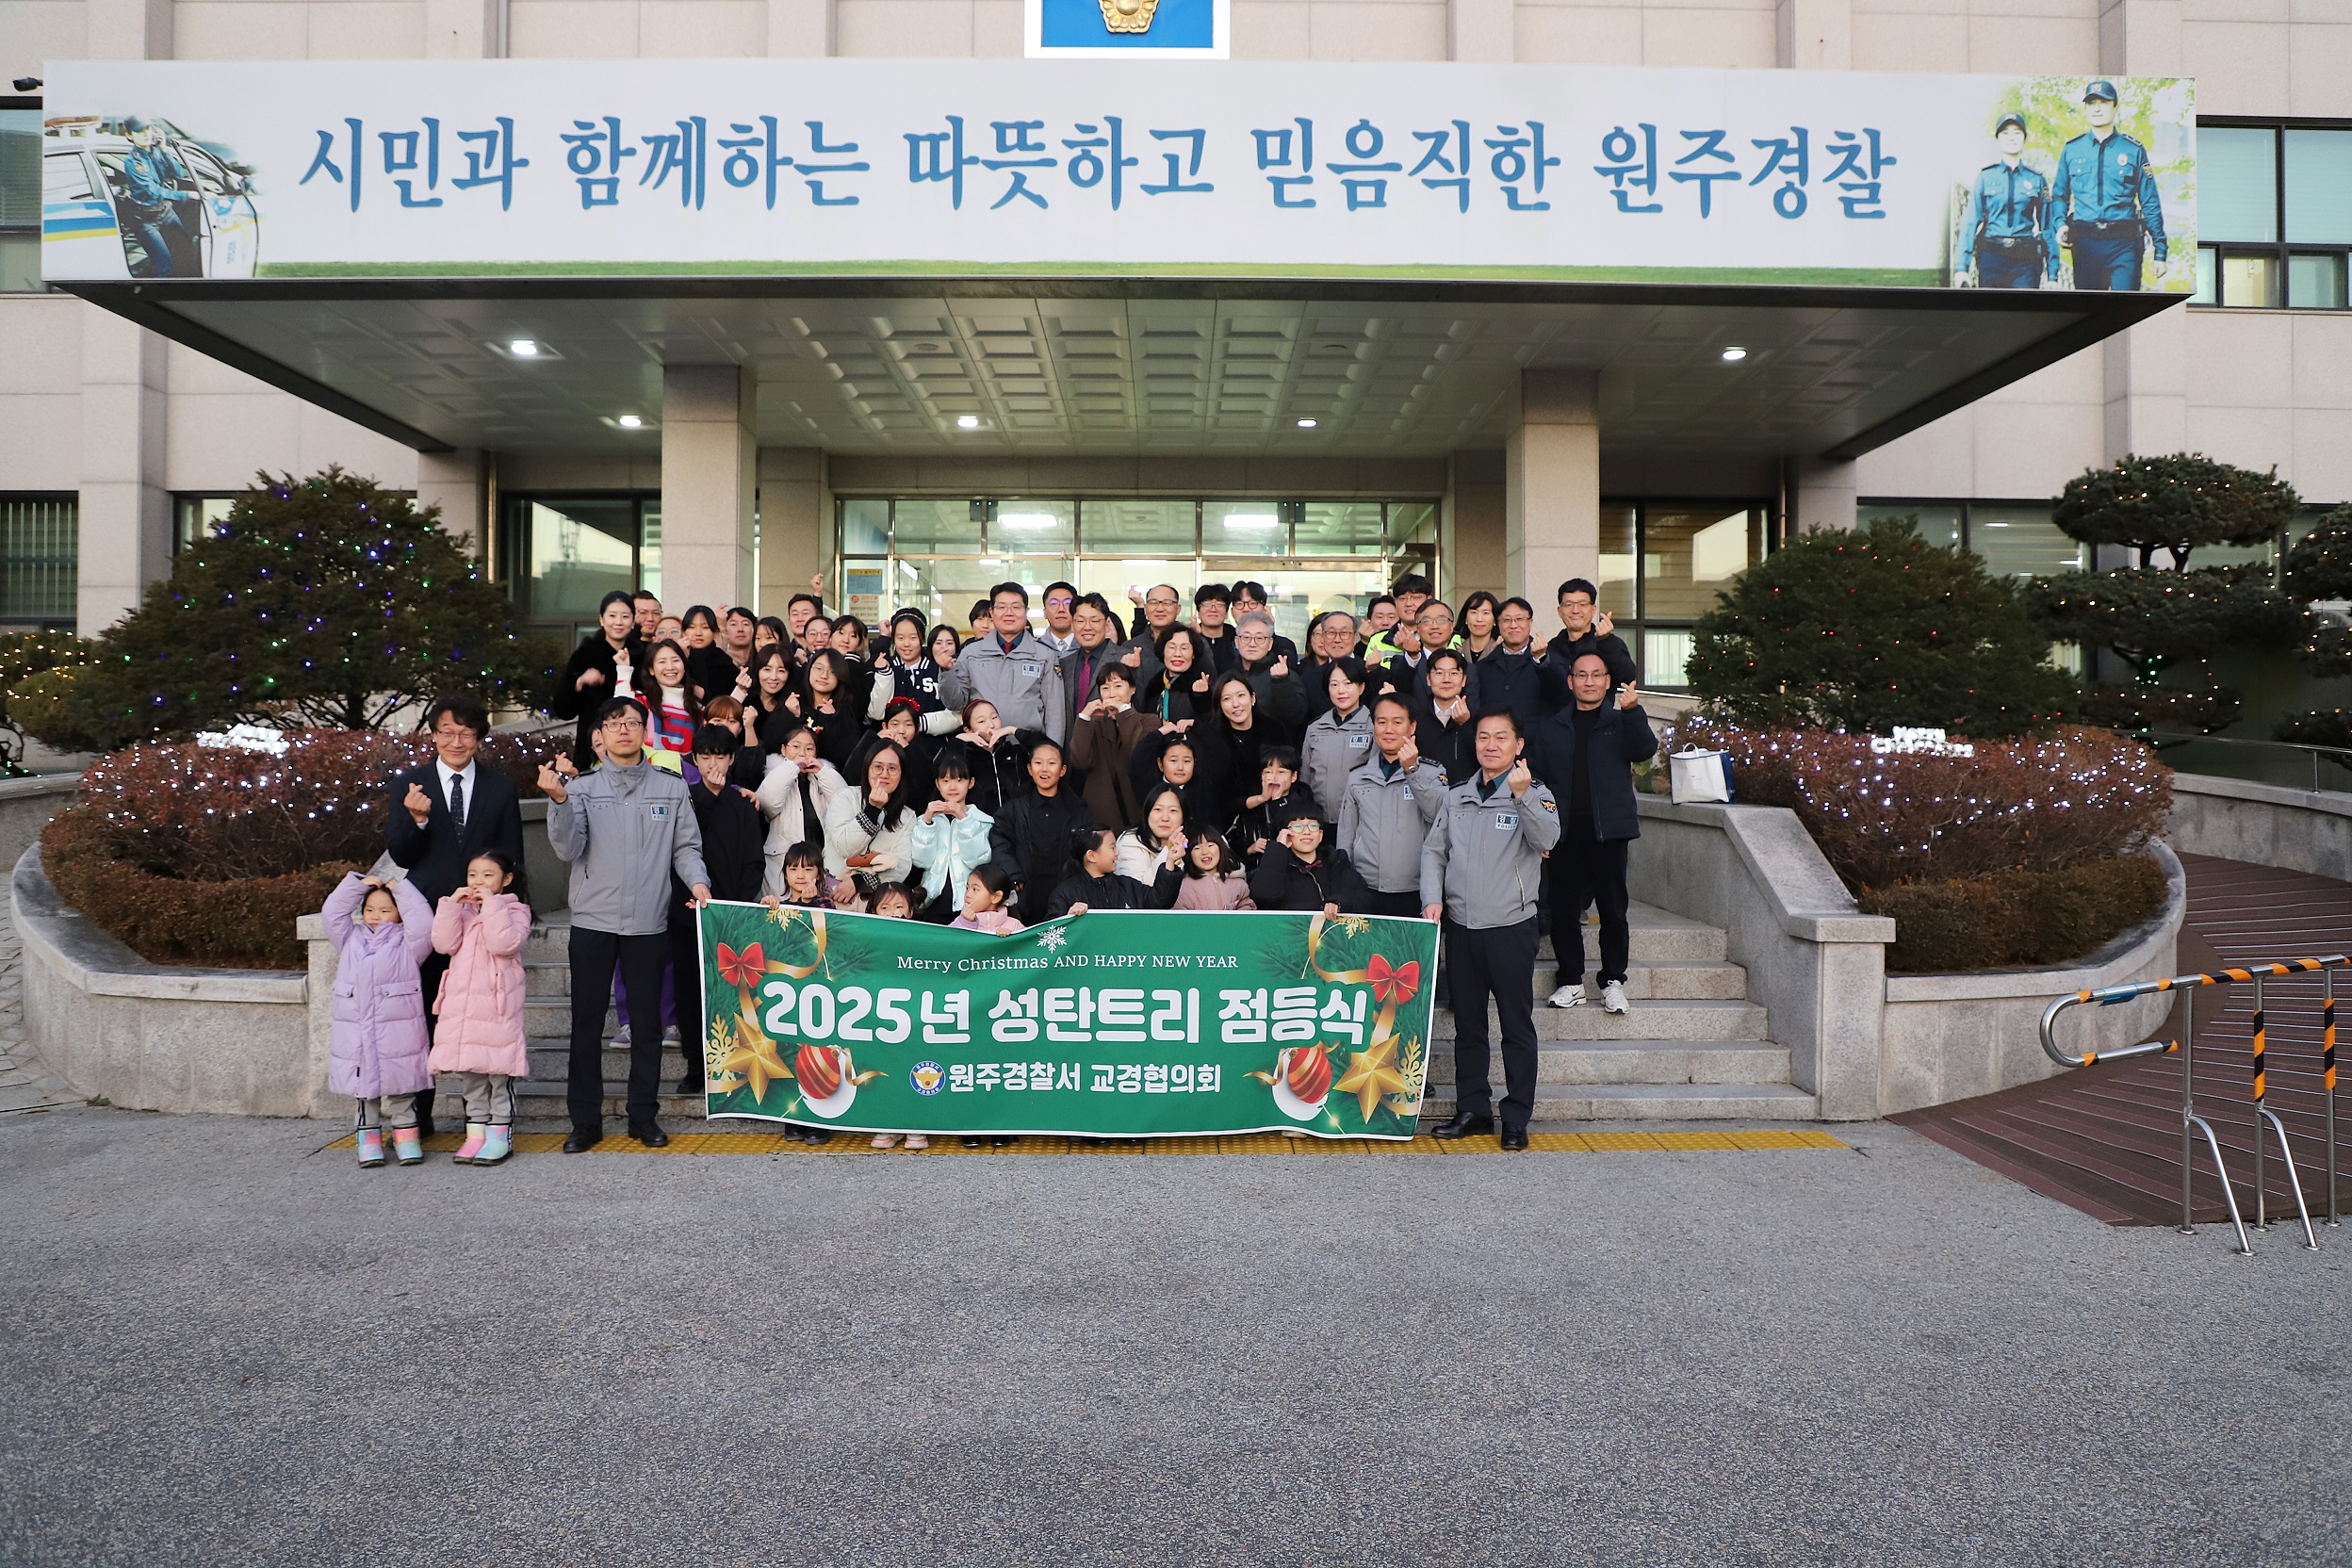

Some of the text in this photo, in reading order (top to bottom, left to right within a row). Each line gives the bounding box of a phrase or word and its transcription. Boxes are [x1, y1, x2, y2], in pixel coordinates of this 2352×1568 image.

[300, 114, 1898, 220] 시민과 함께하는 따뜻하고 믿음직한 원주경찰
[896, 955, 1239, 973] Merry Christmas AND HAPPY NEW YEAR
[762, 980, 1368, 1045] 2025년 성탄트리 점등식
[948, 1061, 1222, 1094] 원주경찰서 교경협의회
